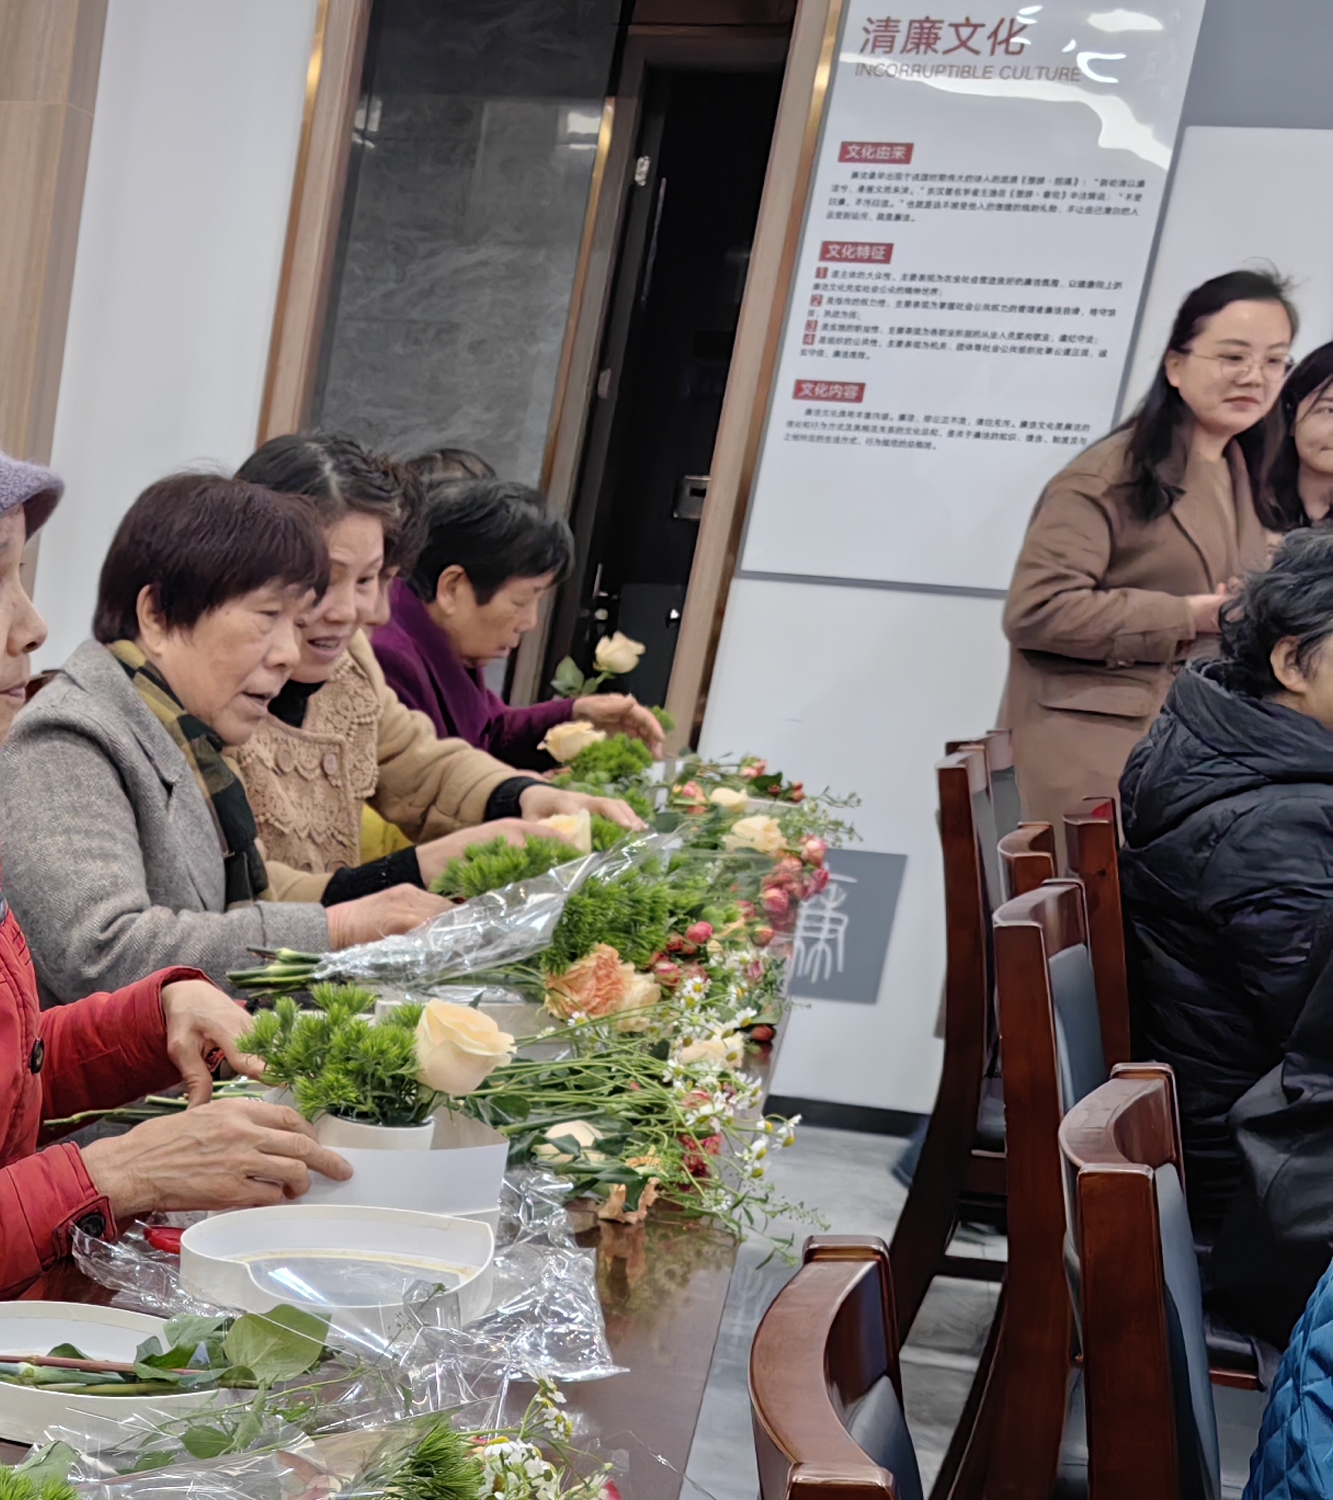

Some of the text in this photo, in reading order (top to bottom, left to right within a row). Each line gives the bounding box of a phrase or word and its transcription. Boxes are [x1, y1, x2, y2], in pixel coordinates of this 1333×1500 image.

[859, 15, 1029, 57] 清廉文化
[854, 62, 1083, 82] INCORRUPTIBLE CULTURE
[844, 143, 907, 161] 文化由来
[824, 243, 887, 260] 文化特征
